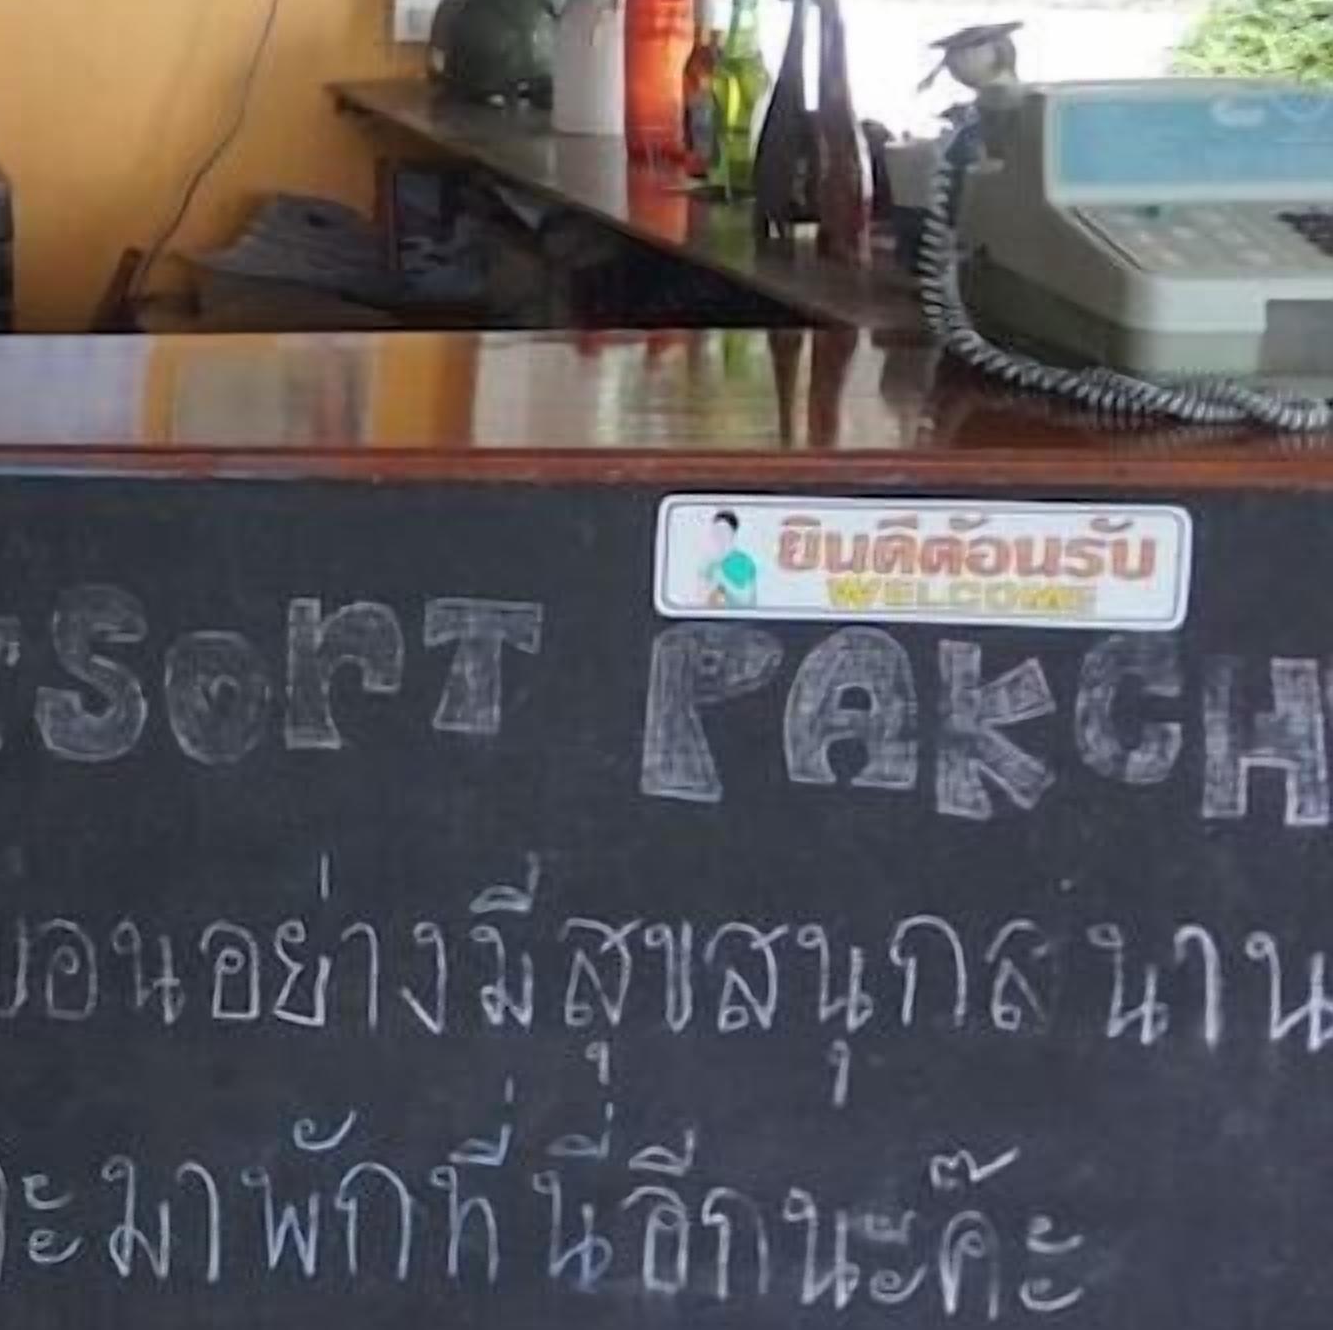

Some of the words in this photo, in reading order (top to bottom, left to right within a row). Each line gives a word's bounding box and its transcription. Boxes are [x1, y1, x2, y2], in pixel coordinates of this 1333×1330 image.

[779, 512, 1156, 580] ยินดีต้อนรับ
[828, 576, 1099, 614] WELCOME
